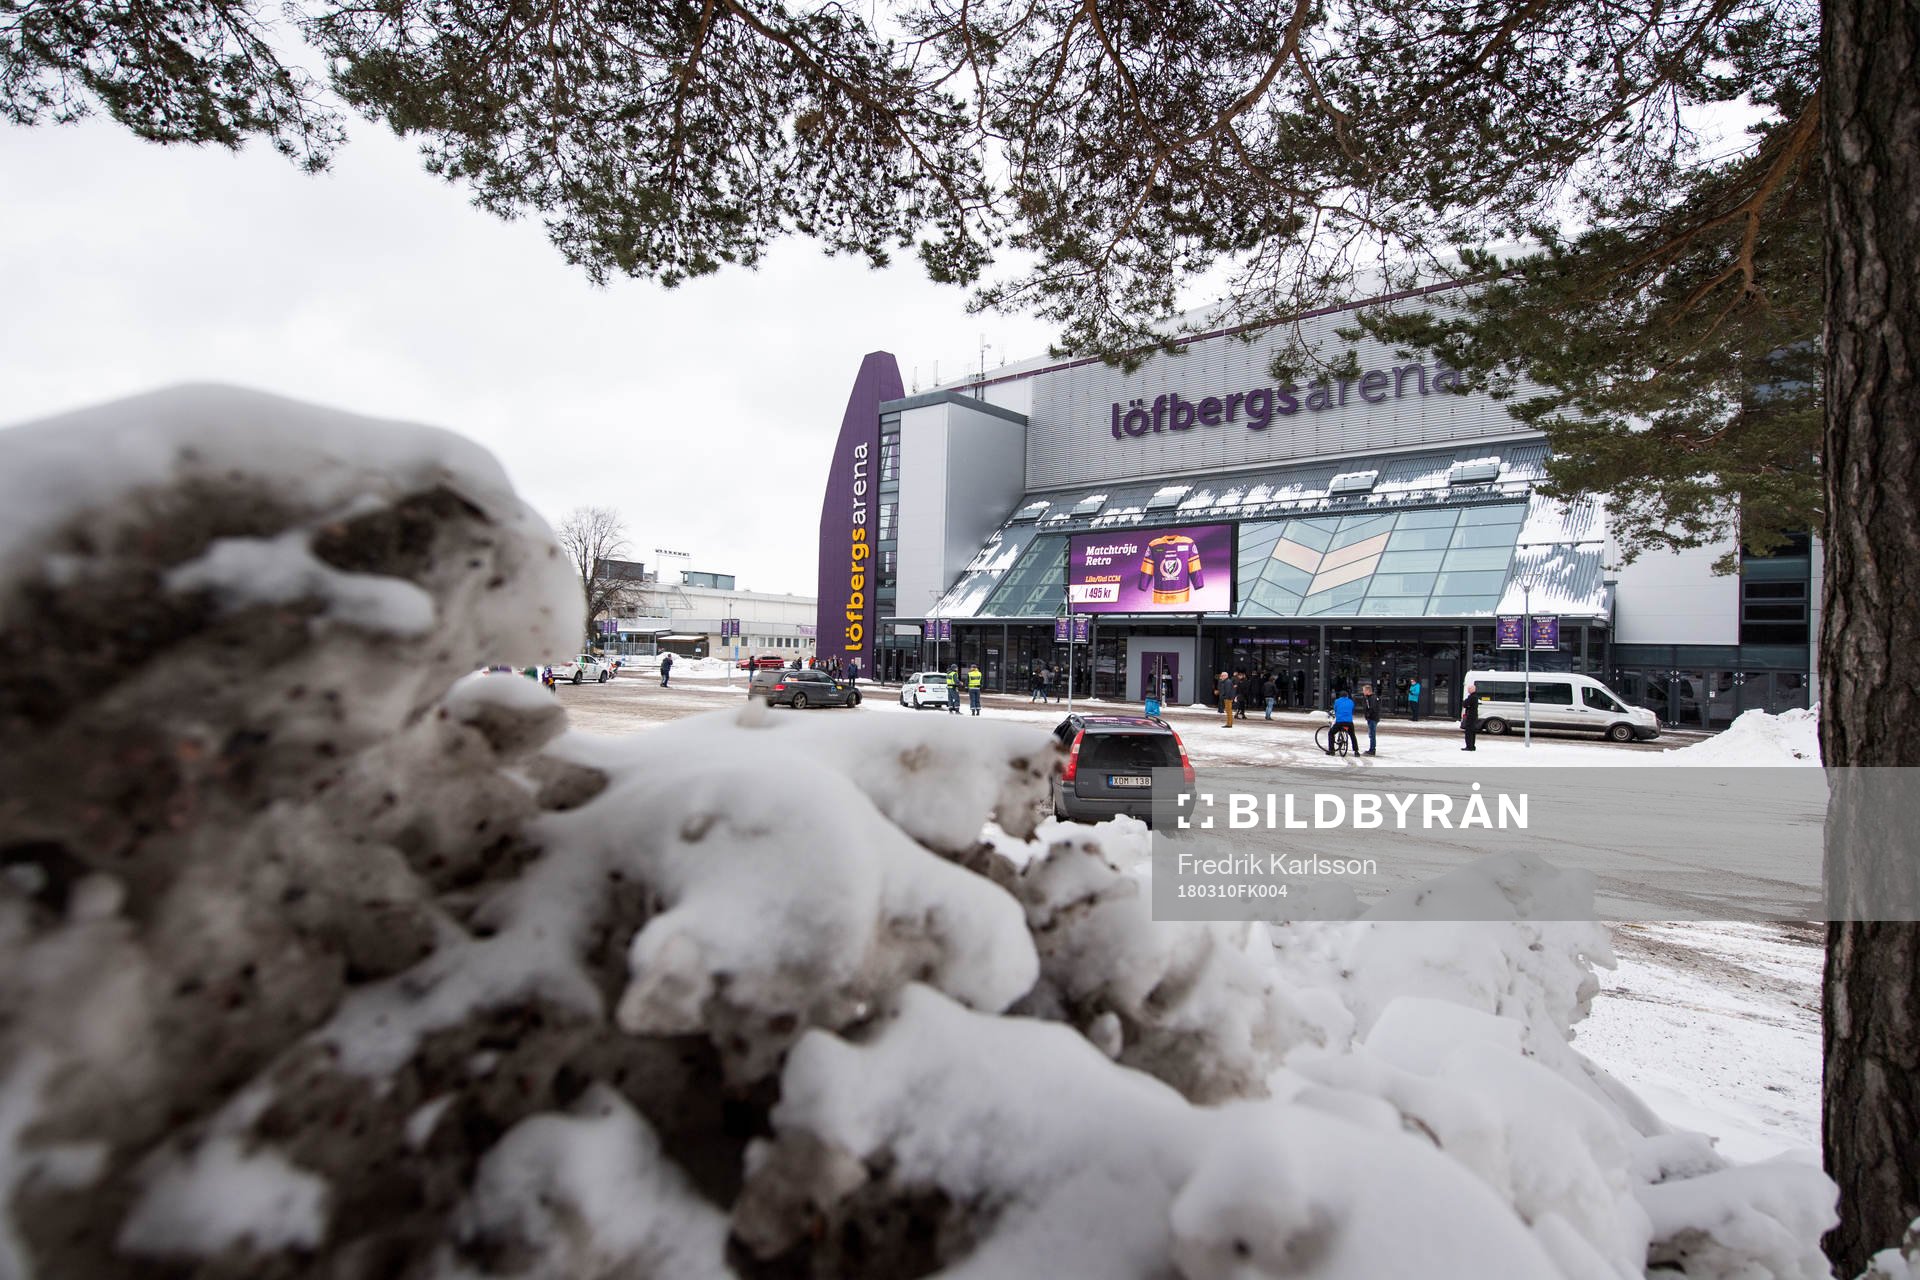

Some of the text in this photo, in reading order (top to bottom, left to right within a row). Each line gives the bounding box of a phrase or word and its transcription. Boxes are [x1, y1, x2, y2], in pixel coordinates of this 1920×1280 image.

[845, 442, 870, 652] löfbergsarena
[1086, 544, 1138, 556] Matchtröja
[1086, 556, 1112, 566] Retro
[1089, 588, 1103, 598] 495
[1104, 588, 1112, 598] kr
[1136, 777, 1150, 785] 138
